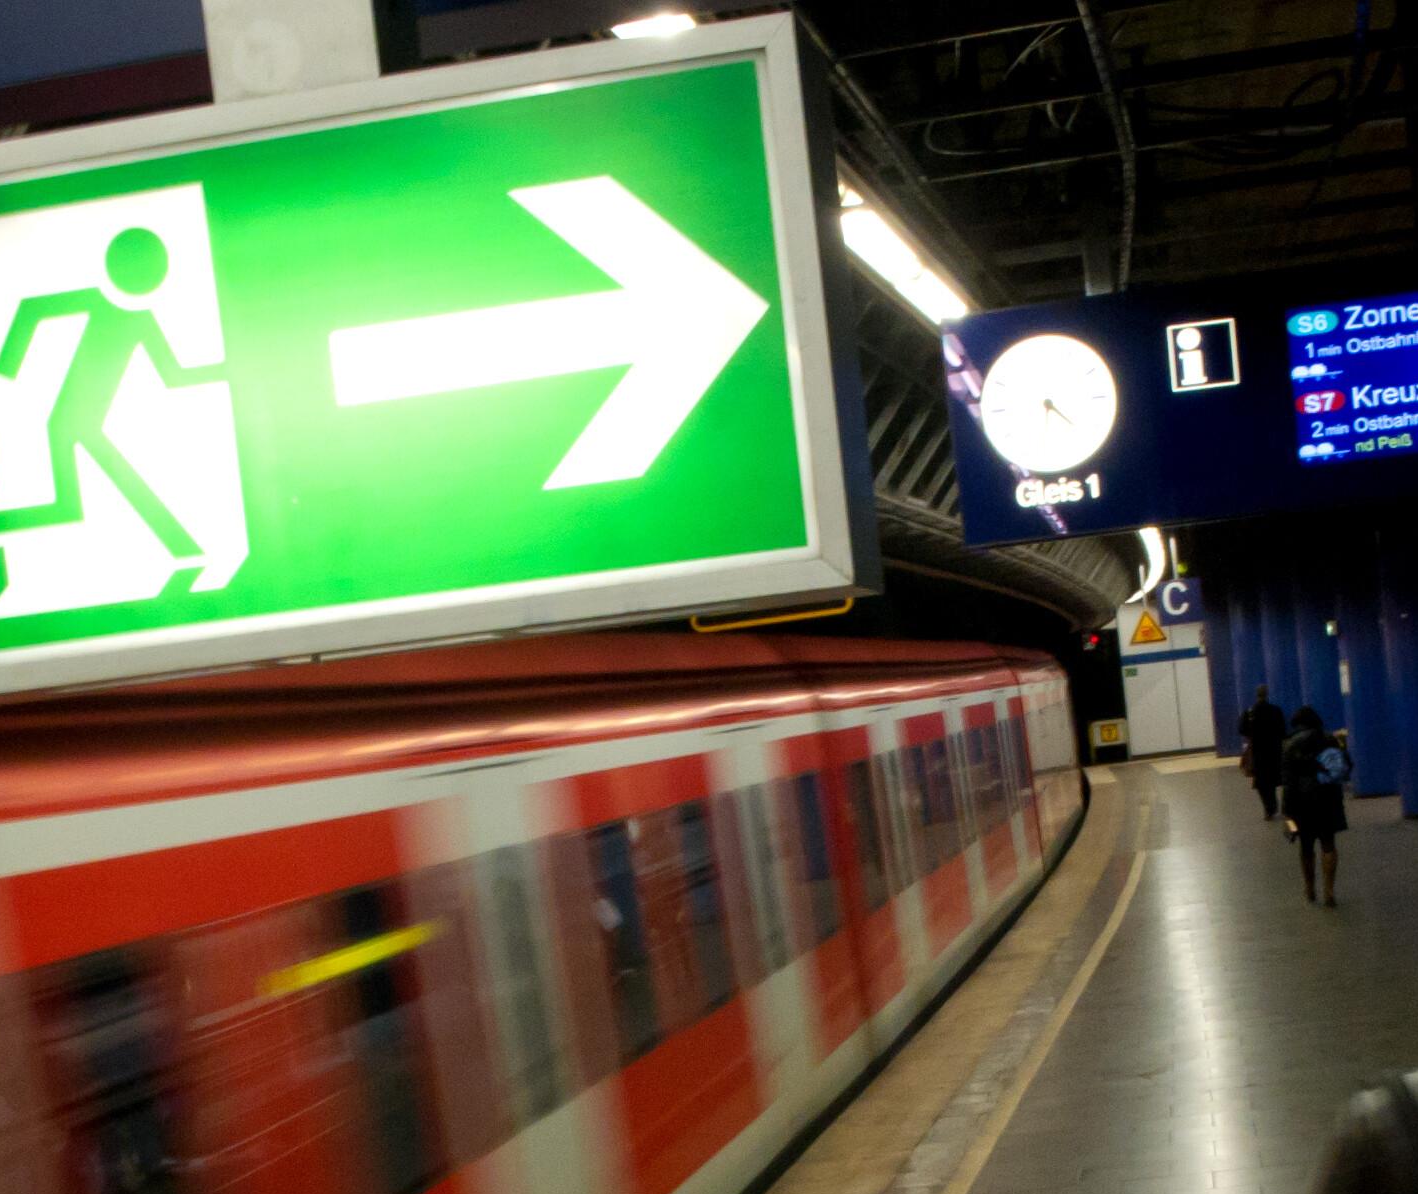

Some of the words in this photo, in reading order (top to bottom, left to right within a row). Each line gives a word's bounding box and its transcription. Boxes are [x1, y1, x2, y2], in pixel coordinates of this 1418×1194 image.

[1298, 313, 1329, 333] S6
[1305, 342, 1315, 358] 1
[1317, 345, 1342, 358] min
[1303, 391, 1336, 413] S7
[1311, 421, 1325, 438] 2
[1325, 424, 1349, 436] min
[1015, 476, 1084, 508] Gleis
[1085, 473, 1100, 499] 1
[1162, 581, 1190, 616] C
